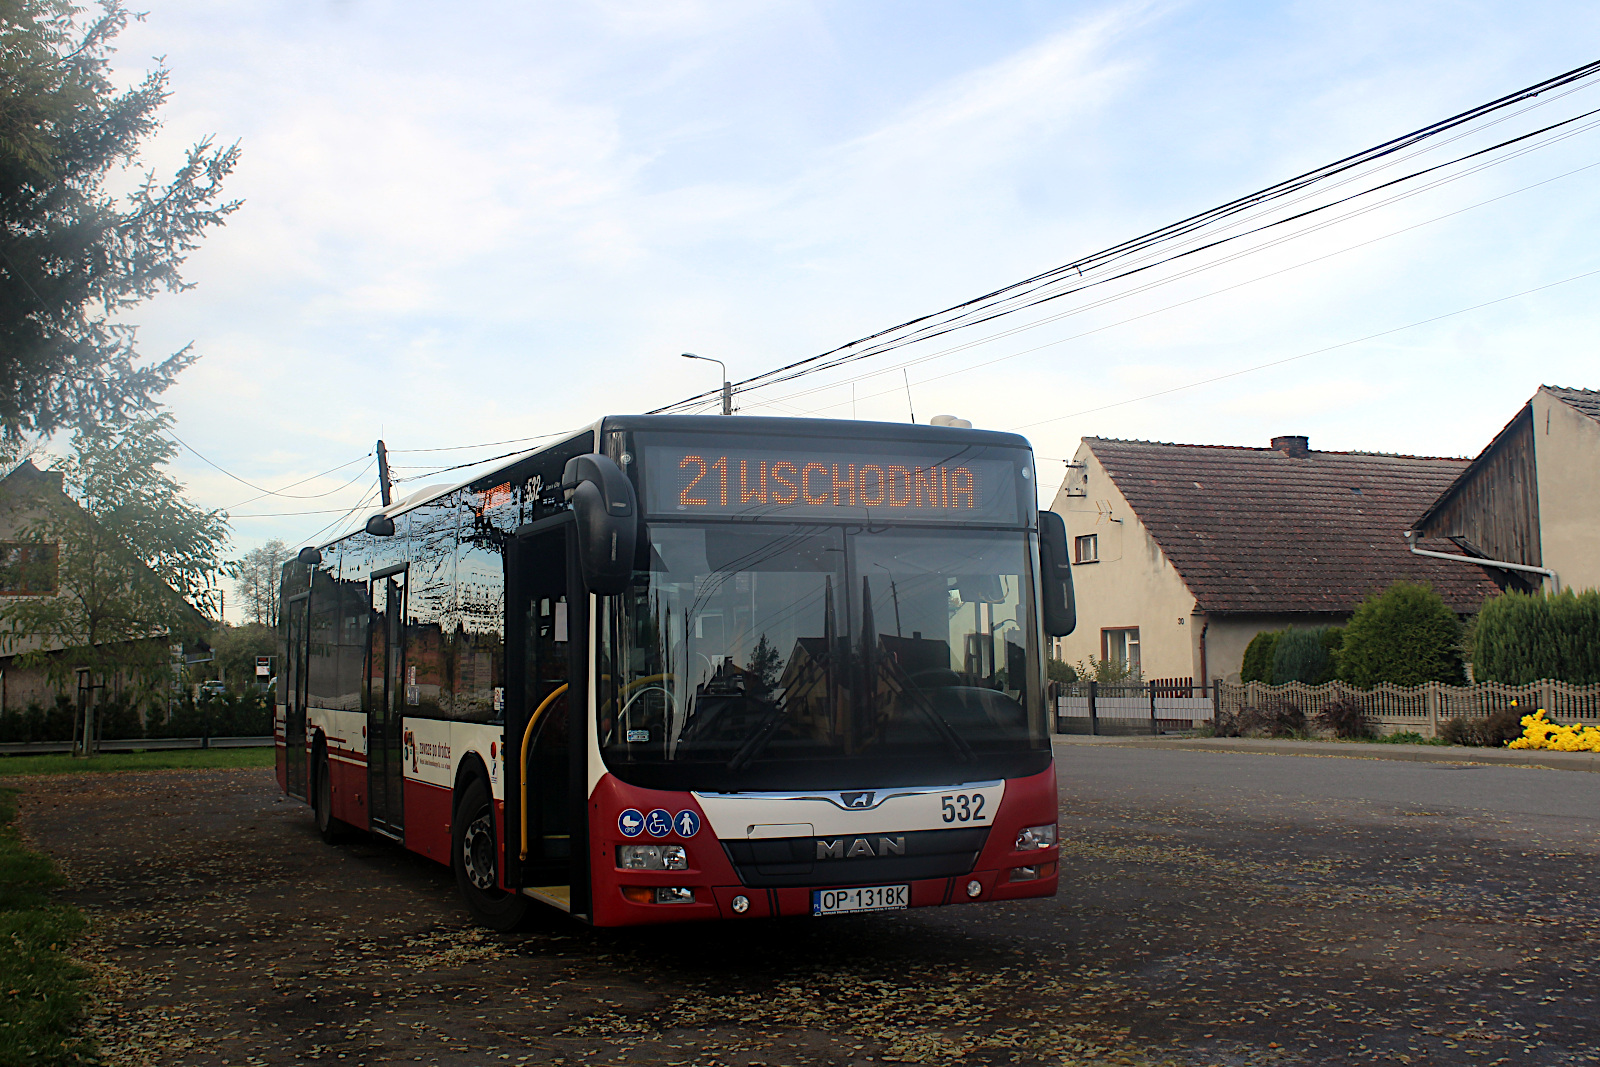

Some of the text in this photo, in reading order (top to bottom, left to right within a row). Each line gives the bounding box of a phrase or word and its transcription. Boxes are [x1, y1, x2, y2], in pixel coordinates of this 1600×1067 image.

[524, 474, 541, 502] 532
[678, 455, 975, 509] 21 WSCHODNIA
[1177, 617, 1185, 625] 30
[941, 793, 986, 823] 532
[816, 836, 906, 860] MAN
[823, 886, 906, 910] OP 1318K
